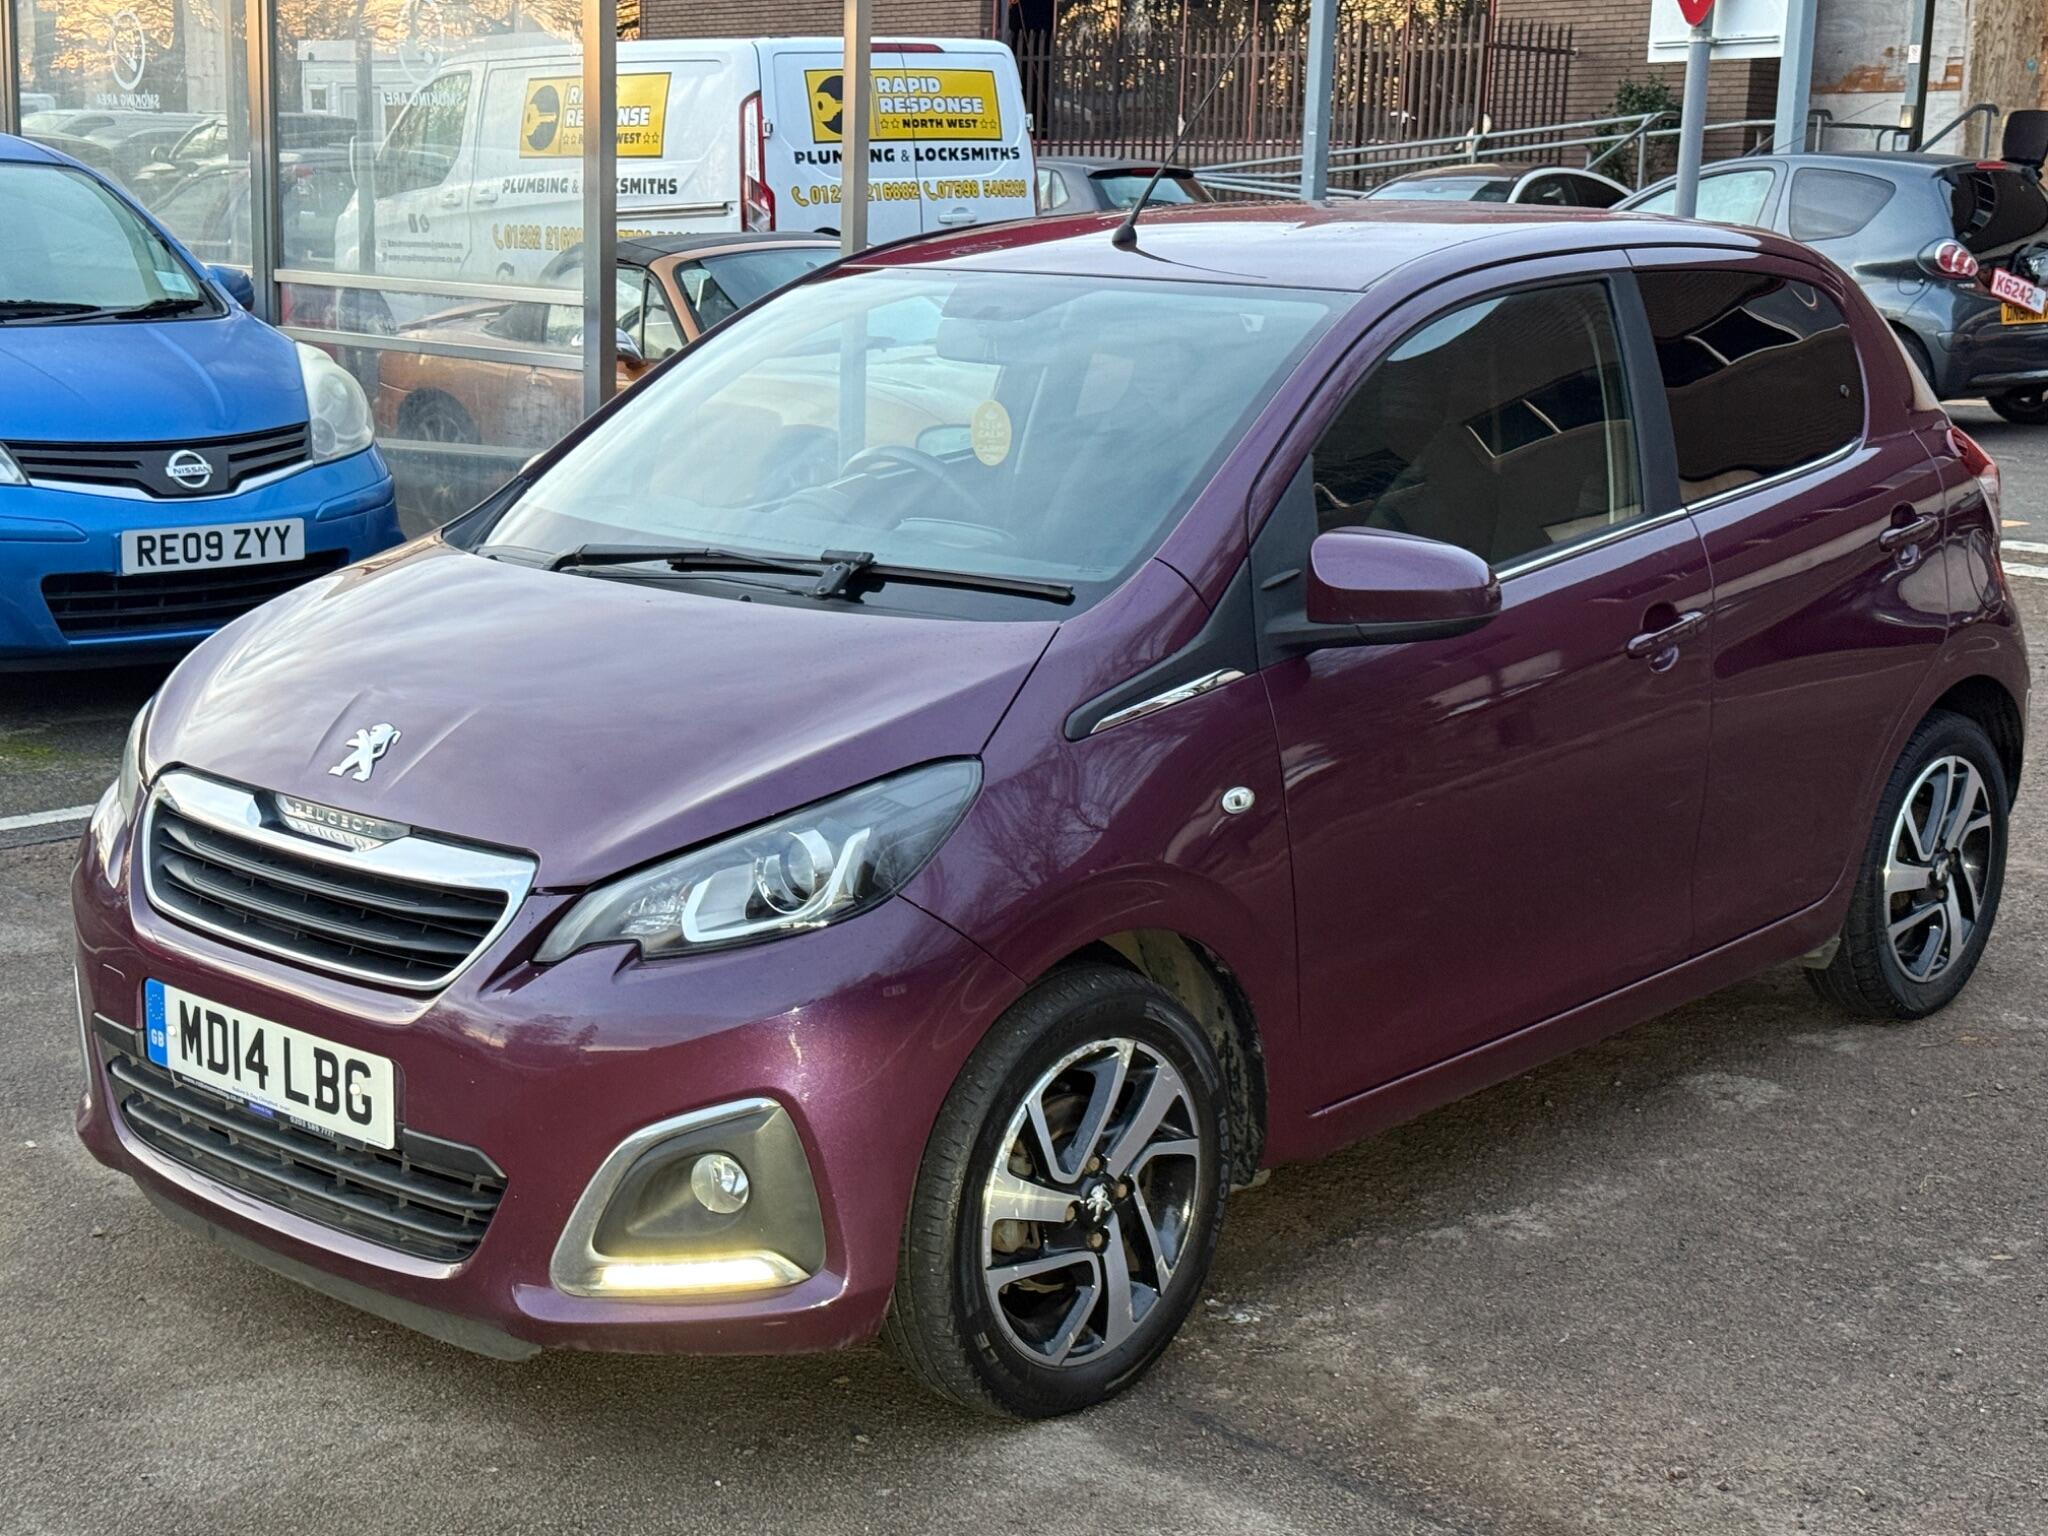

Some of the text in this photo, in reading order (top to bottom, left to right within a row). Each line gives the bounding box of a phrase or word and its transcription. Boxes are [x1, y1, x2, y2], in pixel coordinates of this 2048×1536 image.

[876, 76, 941, 93] RAPID
[879, 96, 983, 114] RESPONSE
[565, 105, 650, 128] RENSE
[902, 118, 978, 128] NORTH WEST
[794, 147, 1021, 164] PLUMNG & LOCKSMITHS
[502, 177, 569, 195] PLUMBING
[572, 180, 579, 193] &
[173, 464, 212, 475] NISSAN
[136, 524, 291, 567] RE09 ZYY
[294, 802, 376, 834] PEUGEOT
[151, 1028, 165, 1048] GB
[179, 1000, 372, 1126] MD14 LBG
